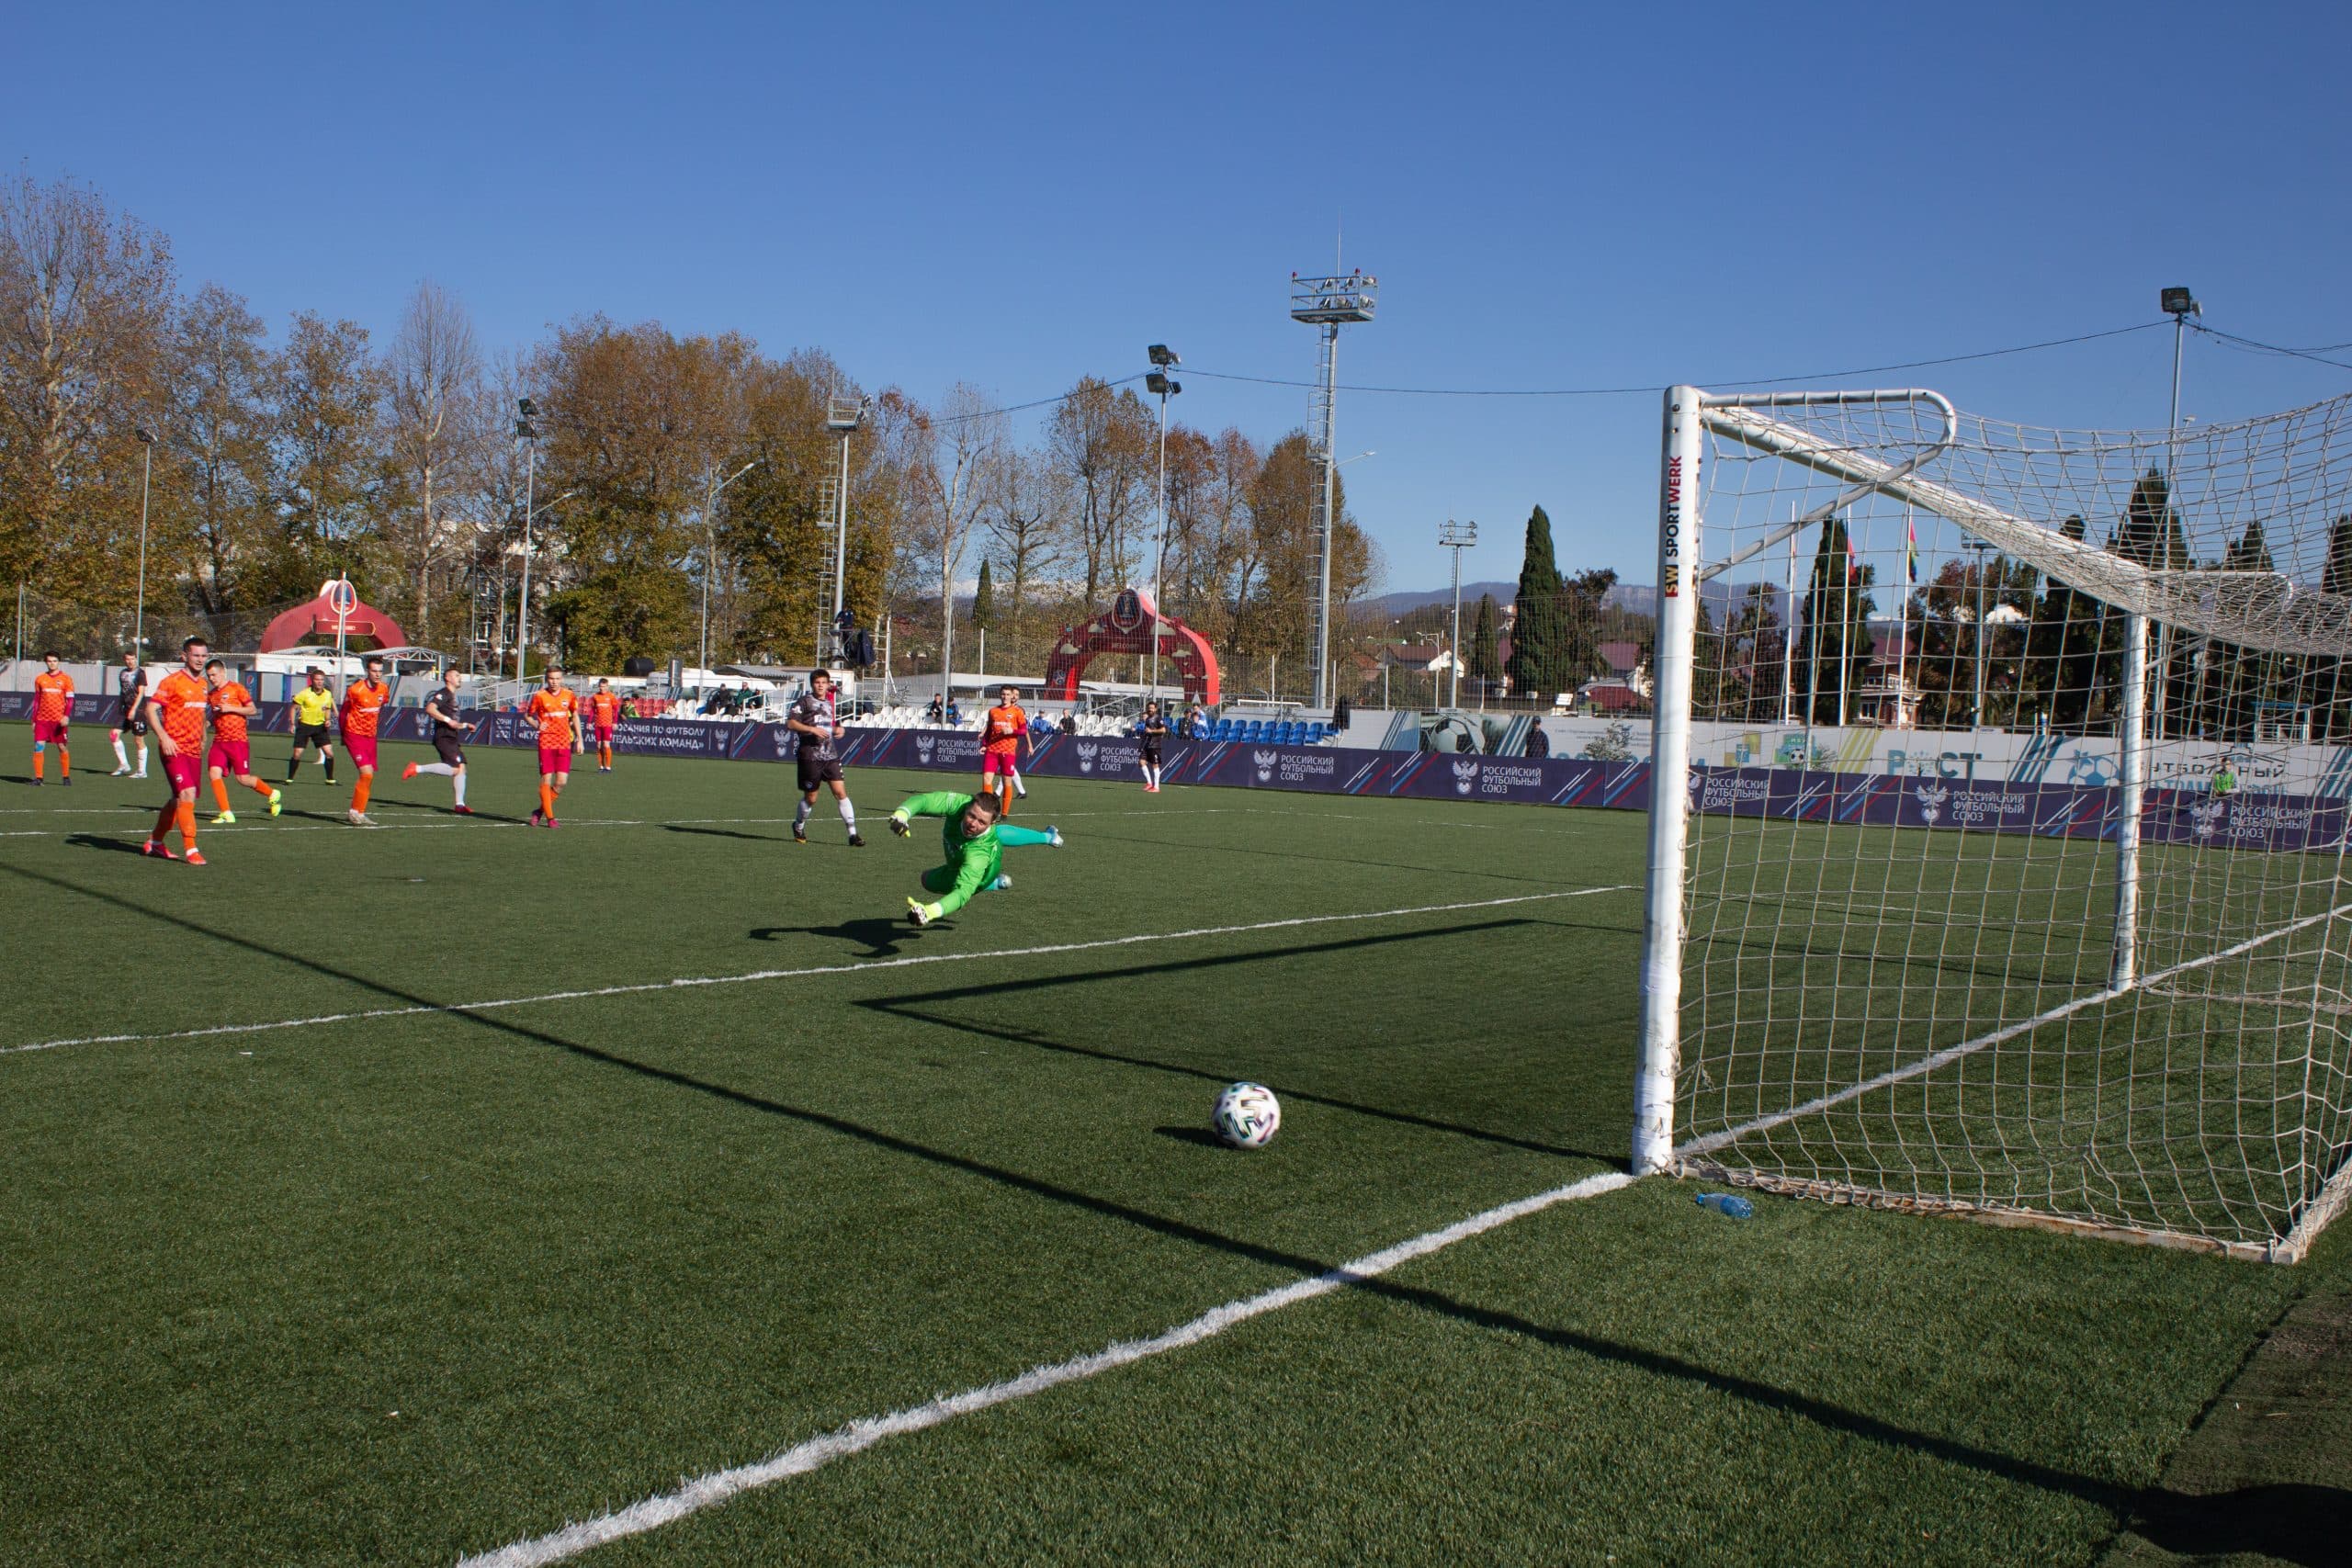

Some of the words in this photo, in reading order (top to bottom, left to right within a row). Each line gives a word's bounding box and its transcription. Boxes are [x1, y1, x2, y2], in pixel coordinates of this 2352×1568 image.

[1666, 456, 1681, 558] SPORTWERK
[1665, 565, 1679, 597] SW
[651, 725, 664, 735] ПО
[665, 727, 706, 738] ФУТБОЛУ
[659, 737, 705, 750] КОМАНД»
[937, 739, 980, 749] РОССИЙСКИЙ
[937, 747, 980, 757] ФУТБОЛЬНЫЙ
[1101, 746, 1141, 756] РОССИЙСК
[937, 754, 956, 762] СОЮЗ
[1101, 755, 1139, 764] ФУТБОЛЬН
[1281, 754, 1335, 766] РОССИЙСКИЙ
[1100, 763, 1121, 772] СОЮЗ
[1281, 763, 1334, 775] ФУТБОЛЬНЫЙ
[1483, 765, 1542, 778] РОССИЙСКИЙ
[1280, 772, 1305, 781] СОЮЗ
[1482, 774, 1542, 787] ФУТБОЛЬНЫЙ
[1481, 784, 1508, 794] СОЮЗ
[1704, 796, 1733, 807] СОЮЗ
[1953, 790, 2026, 804] РОССИЙСКИЙ
[1952, 800, 2026, 814] ФУТБОЛЬНЫЙ
[2231, 806, 2312, 820] РОССИЙСКИЙ
[1952, 810, 1984, 821] СОЮЗ
[2229, 827, 2266, 839] СОЮЗ
